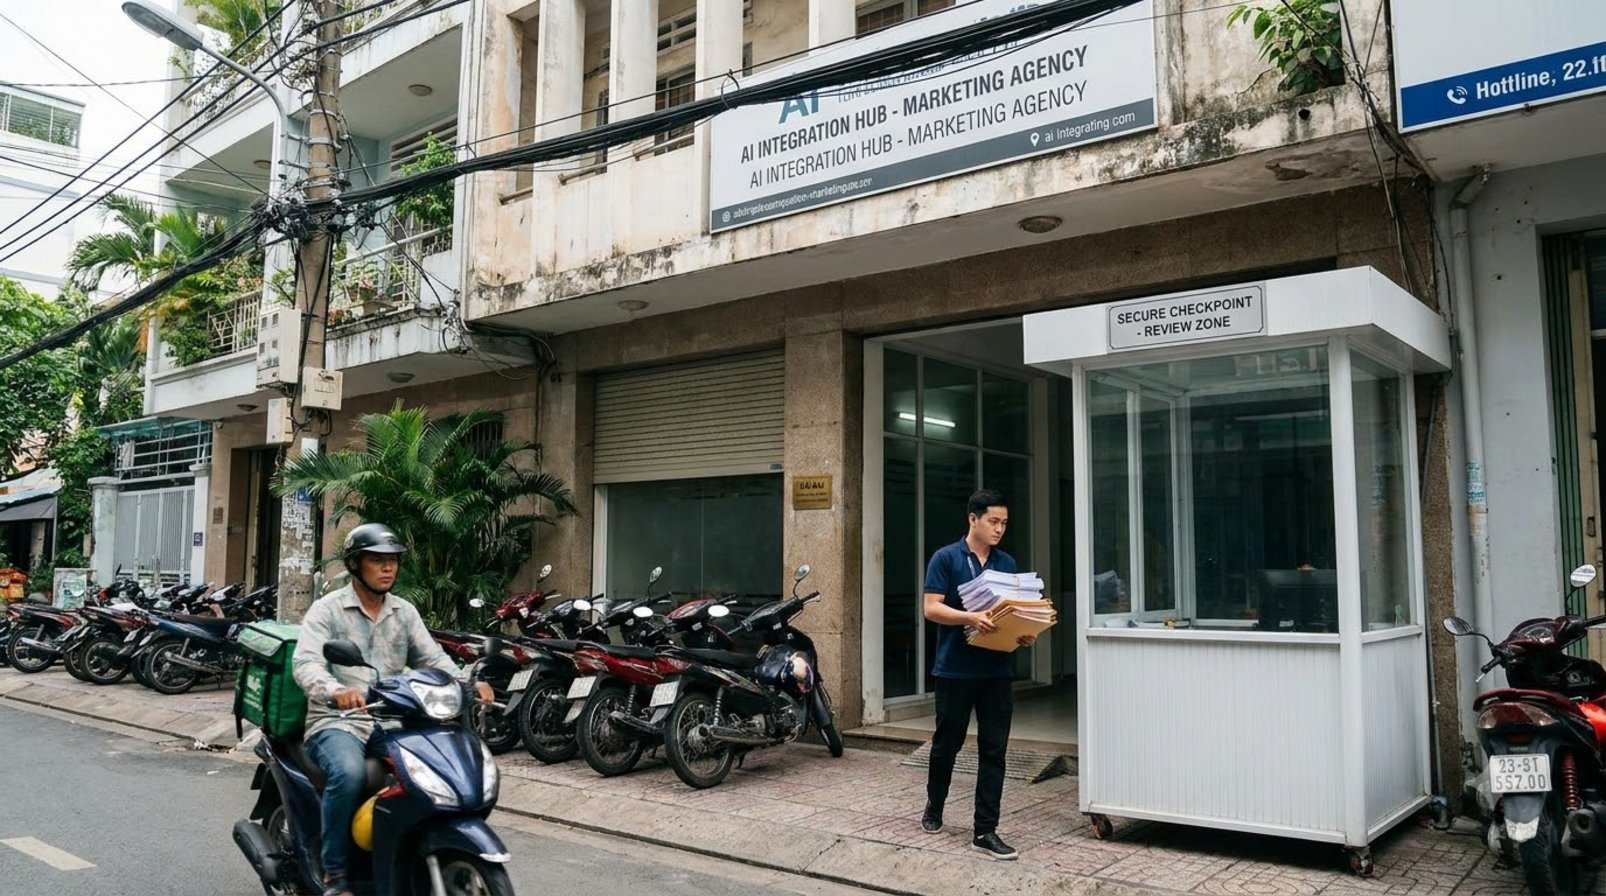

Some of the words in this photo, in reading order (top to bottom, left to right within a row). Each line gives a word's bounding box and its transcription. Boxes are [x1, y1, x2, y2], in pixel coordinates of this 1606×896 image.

[741, 145, 754, 164] AI
[758, 114, 850, 158] INTEGRATION
[855, 105, 887, 130] HUB
[903, 70, 1005, 117] MARKETING
[1010, 45, 1088, 87] AGENCY
[750, 170, 762, 188] AI
[766, 144, 857, 183] INTEGRATION
[861, 134, 893, 159] HUB
[908, 102, 1006, 146] MARKETING
[1012, 80, 1088, 119] AGENCY
[1113, 112, 1136, 127] com
[1117, 308, 1166, 325] SECURE
[1169, 296, 1252, 318] CHECKPOINT
[1144, 321, 1192, 337] REVIEW
[1195, 315, 1231, 331] ZONE
